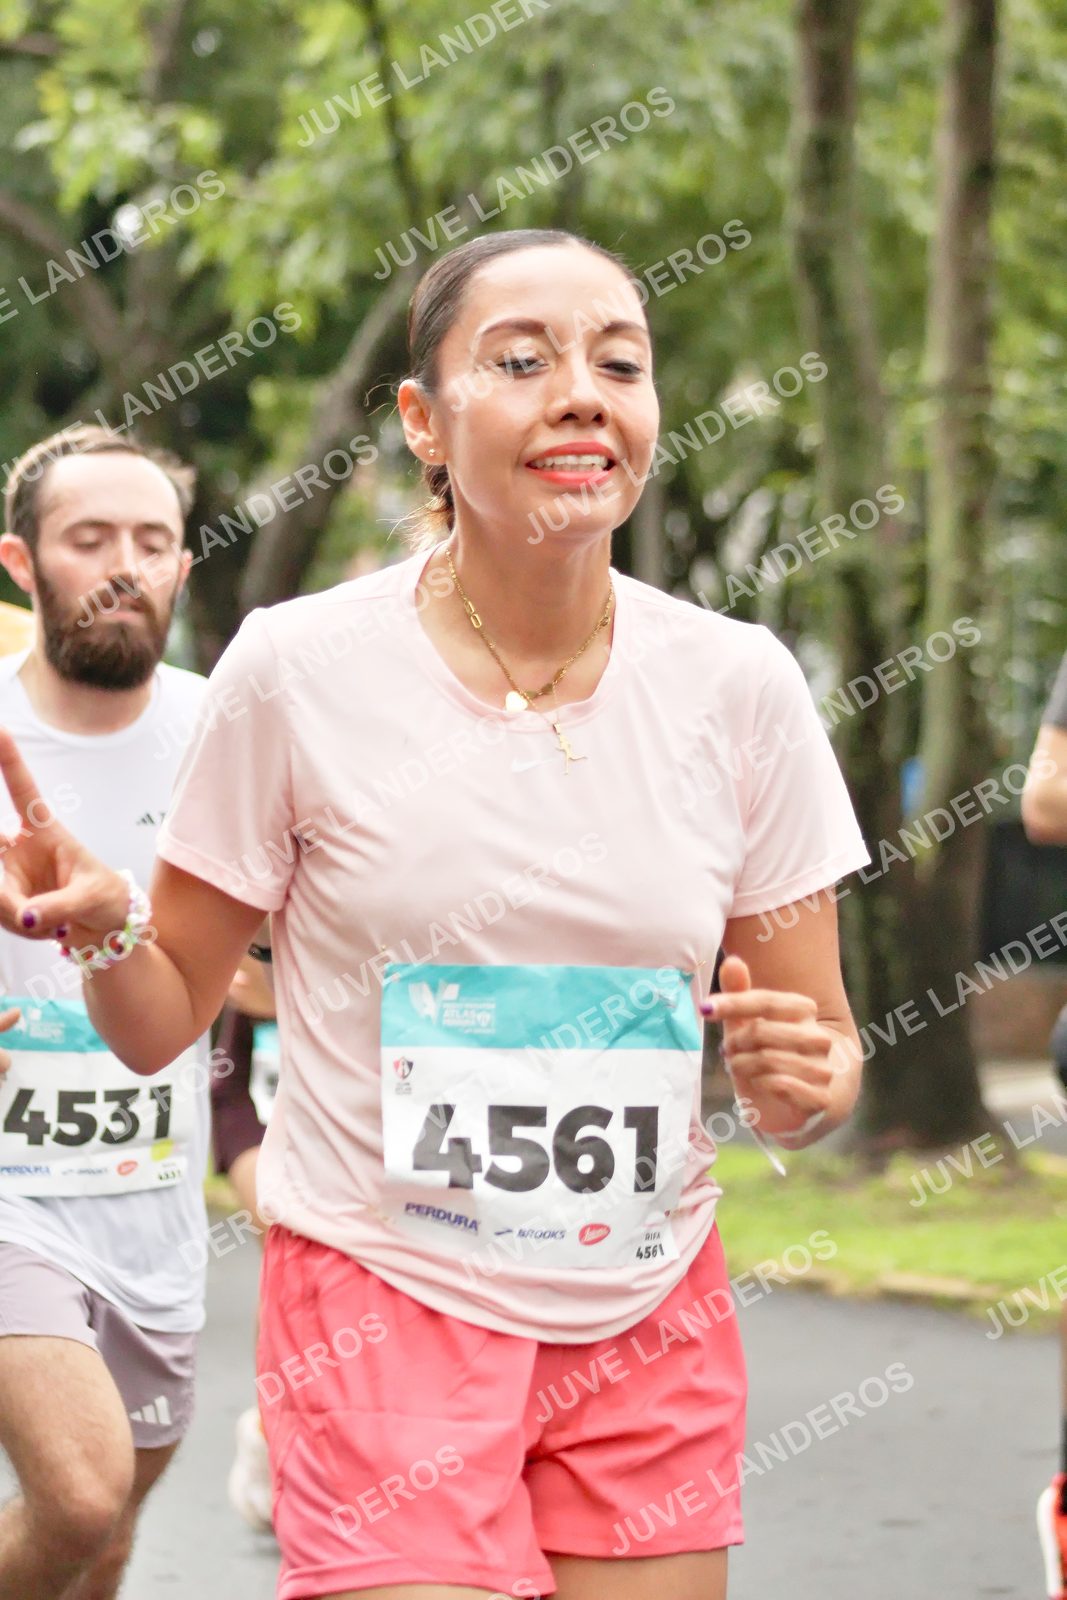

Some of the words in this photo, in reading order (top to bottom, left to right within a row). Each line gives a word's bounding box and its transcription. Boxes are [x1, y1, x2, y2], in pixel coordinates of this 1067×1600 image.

[3, 1083, 173, 1147] 4531
[412, 1103, 660, 1194] 4561
[404, 1202, 479, 1233] PERDURA
[635, 1243, 664, 1260] 4561
